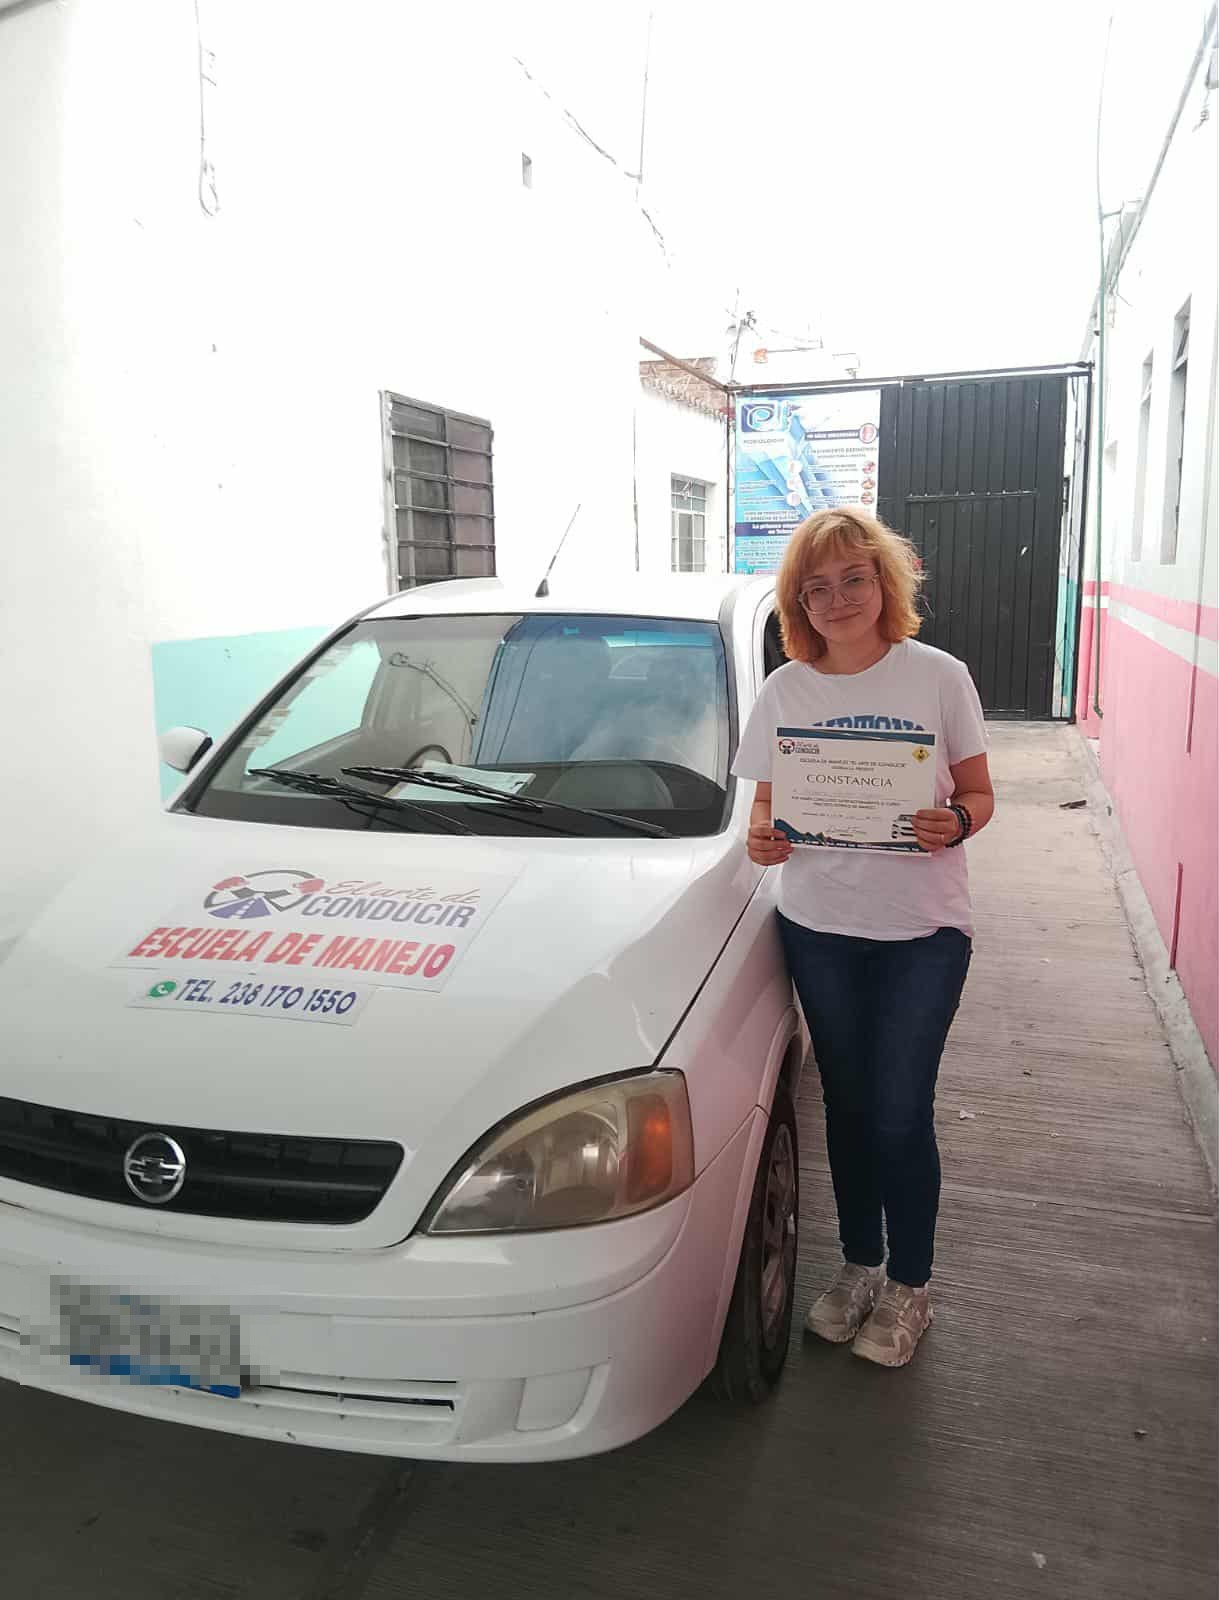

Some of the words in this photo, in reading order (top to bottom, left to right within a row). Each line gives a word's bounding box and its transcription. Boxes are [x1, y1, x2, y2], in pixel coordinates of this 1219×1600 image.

[806, 774, 893, 787] CONSTANCIA
[325, 880, 382, 896] El
[439, 888, 480, 904] de
[301, 895, 476, 928] CONDUCIR
[128, 927, 274, 962] ESCUELA
[264, 932, 325, 966] DE
[312, 935, 456, 978] MANEJO
[175, 978, 217, 1003] TEL.
[219, 982, 262, 1006] 238
[260, 985, 305, 1010] 170
[302, 988, 356, 1015] 1550
